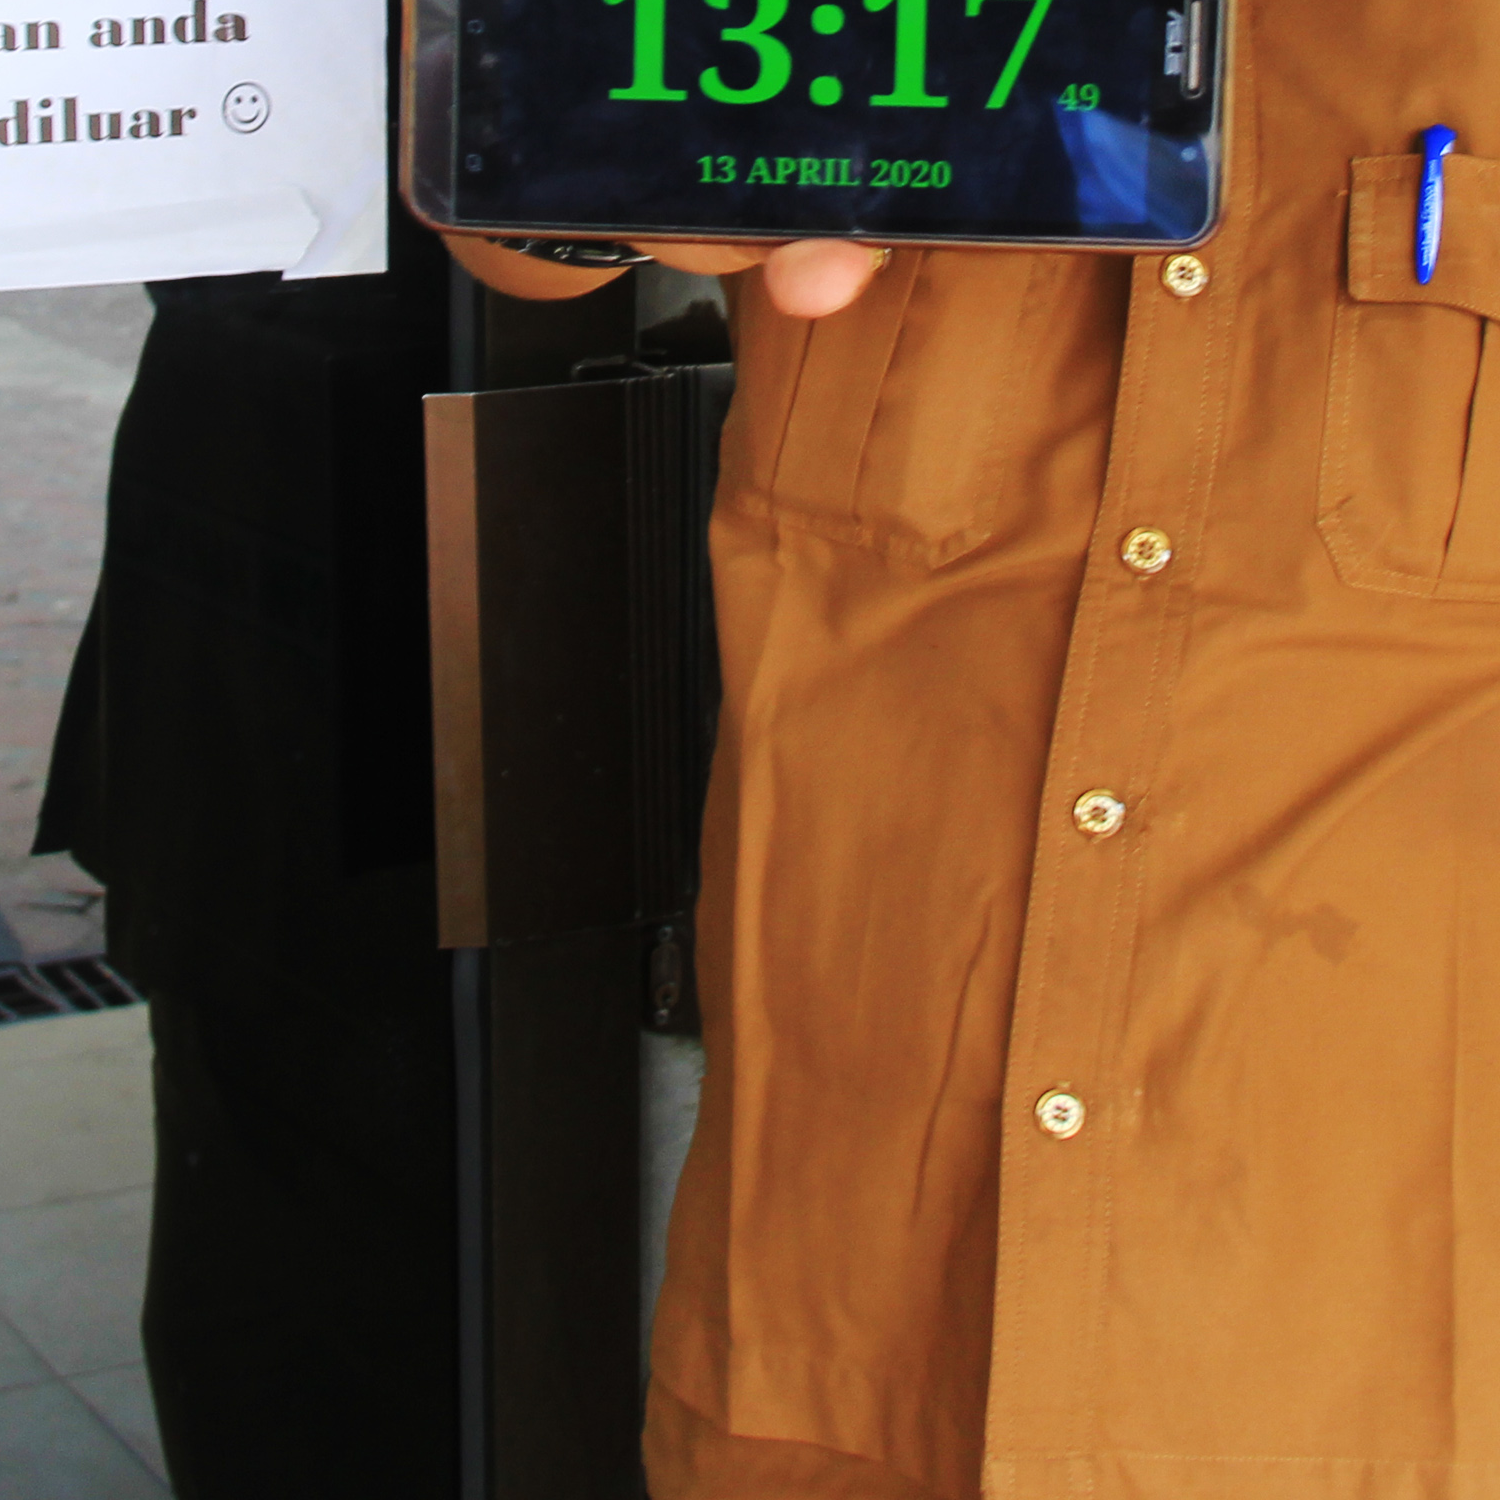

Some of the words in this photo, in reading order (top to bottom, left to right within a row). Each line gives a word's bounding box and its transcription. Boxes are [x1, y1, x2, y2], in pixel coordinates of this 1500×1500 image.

[1057, 83, 1101, 113] 49
[696, 155, 737, 185] 13
[746, 155, 862, 188] APRIL
[869, 158, 952, 190] 2020
